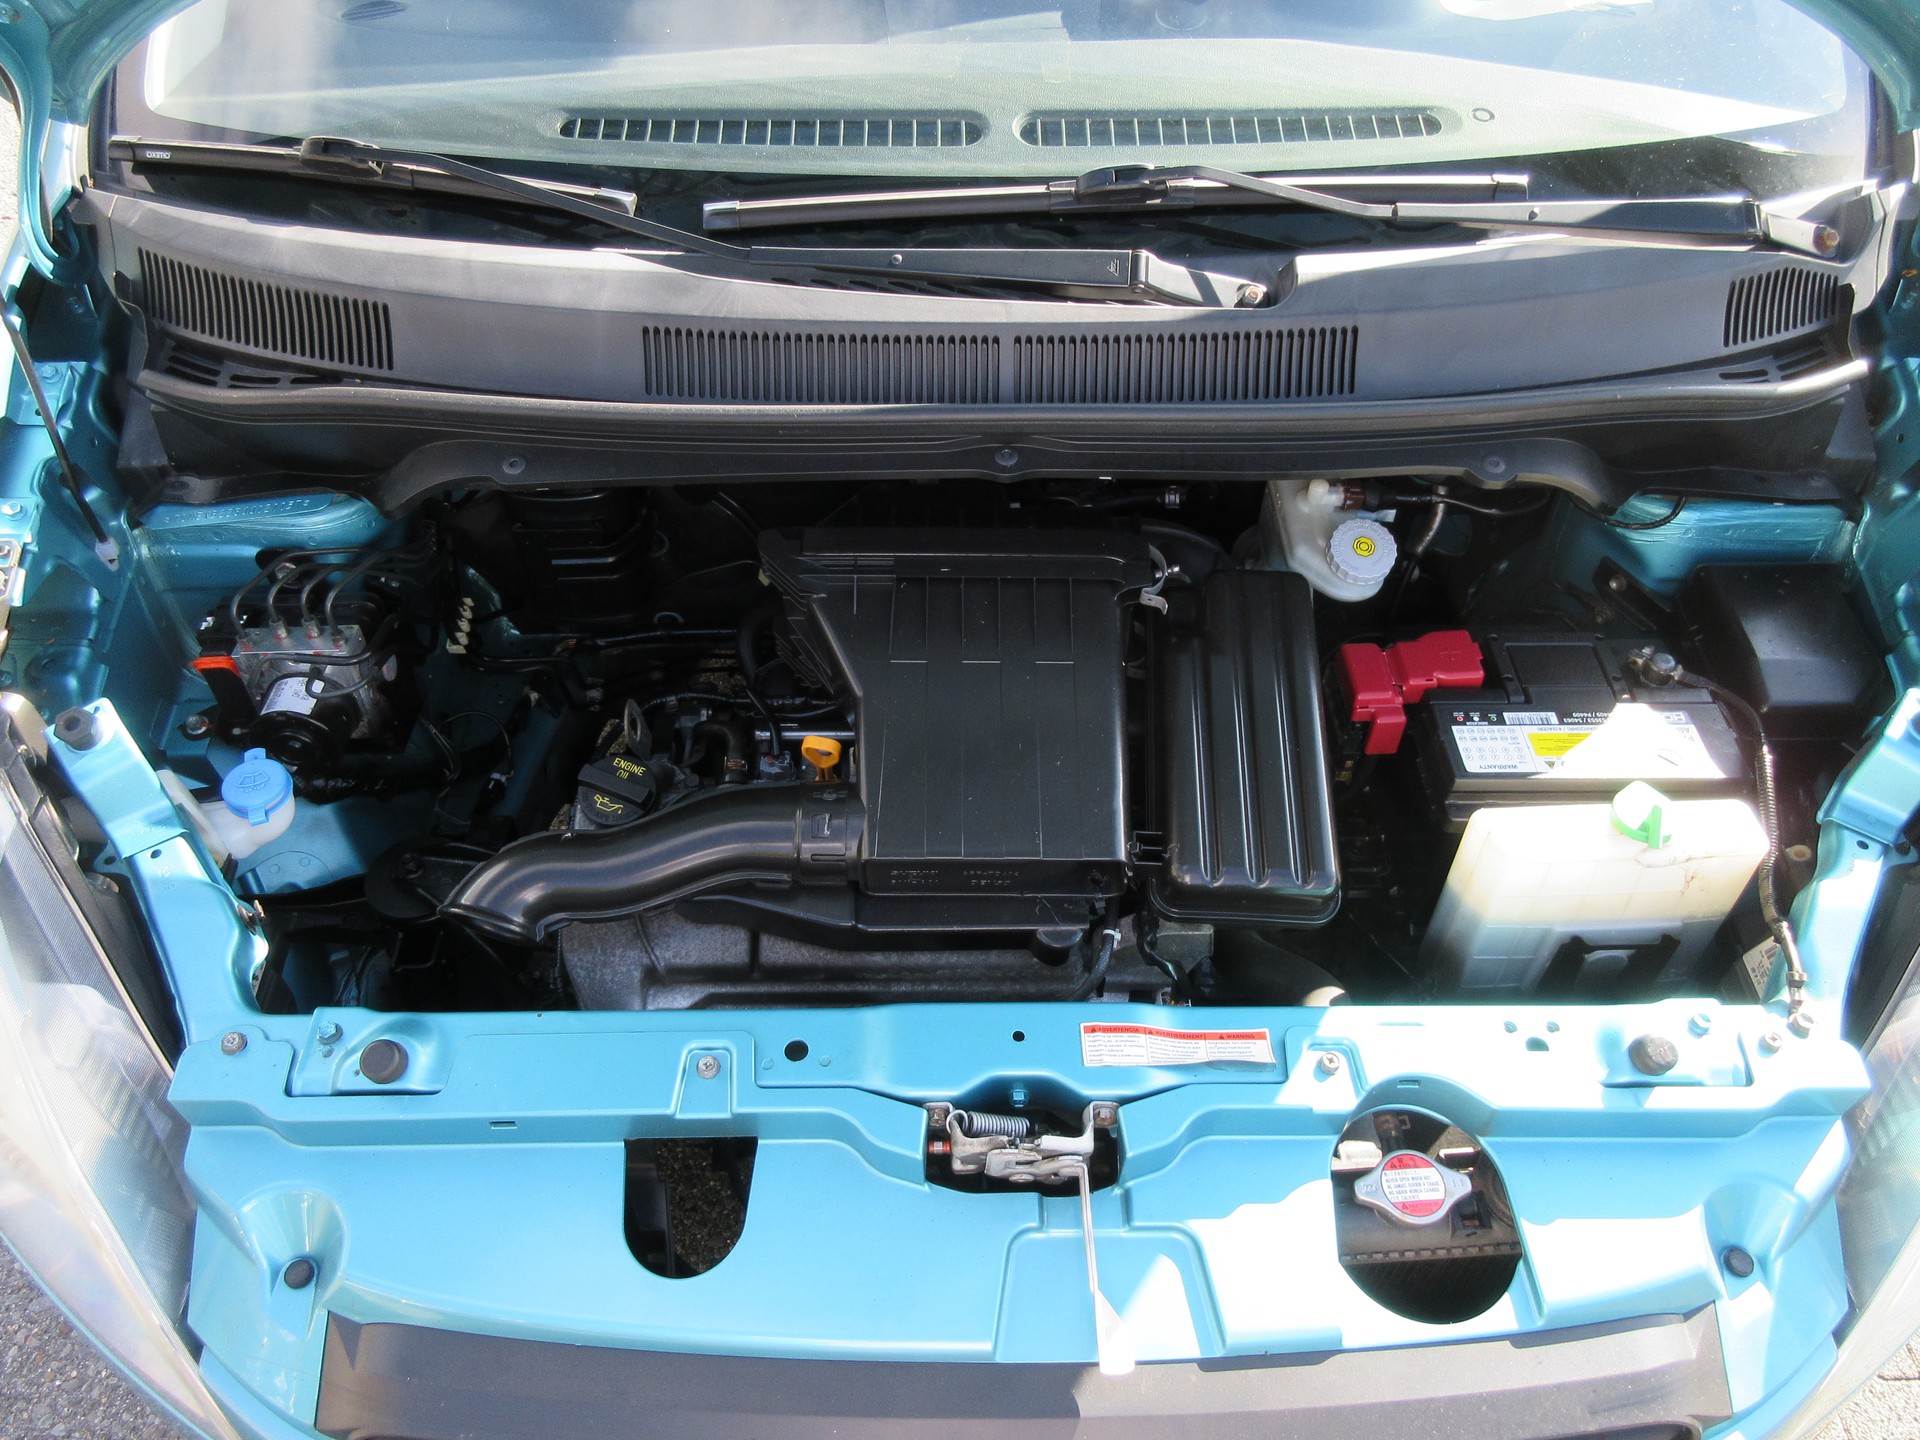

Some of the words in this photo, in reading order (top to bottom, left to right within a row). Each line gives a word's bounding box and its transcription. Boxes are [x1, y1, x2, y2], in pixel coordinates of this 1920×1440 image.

[146, 151, 172, 159] OXIMO
[613, 757, 647, 776] ENGINE
[1156, 1030, 1205, 1040] AVERTISSEMENT
